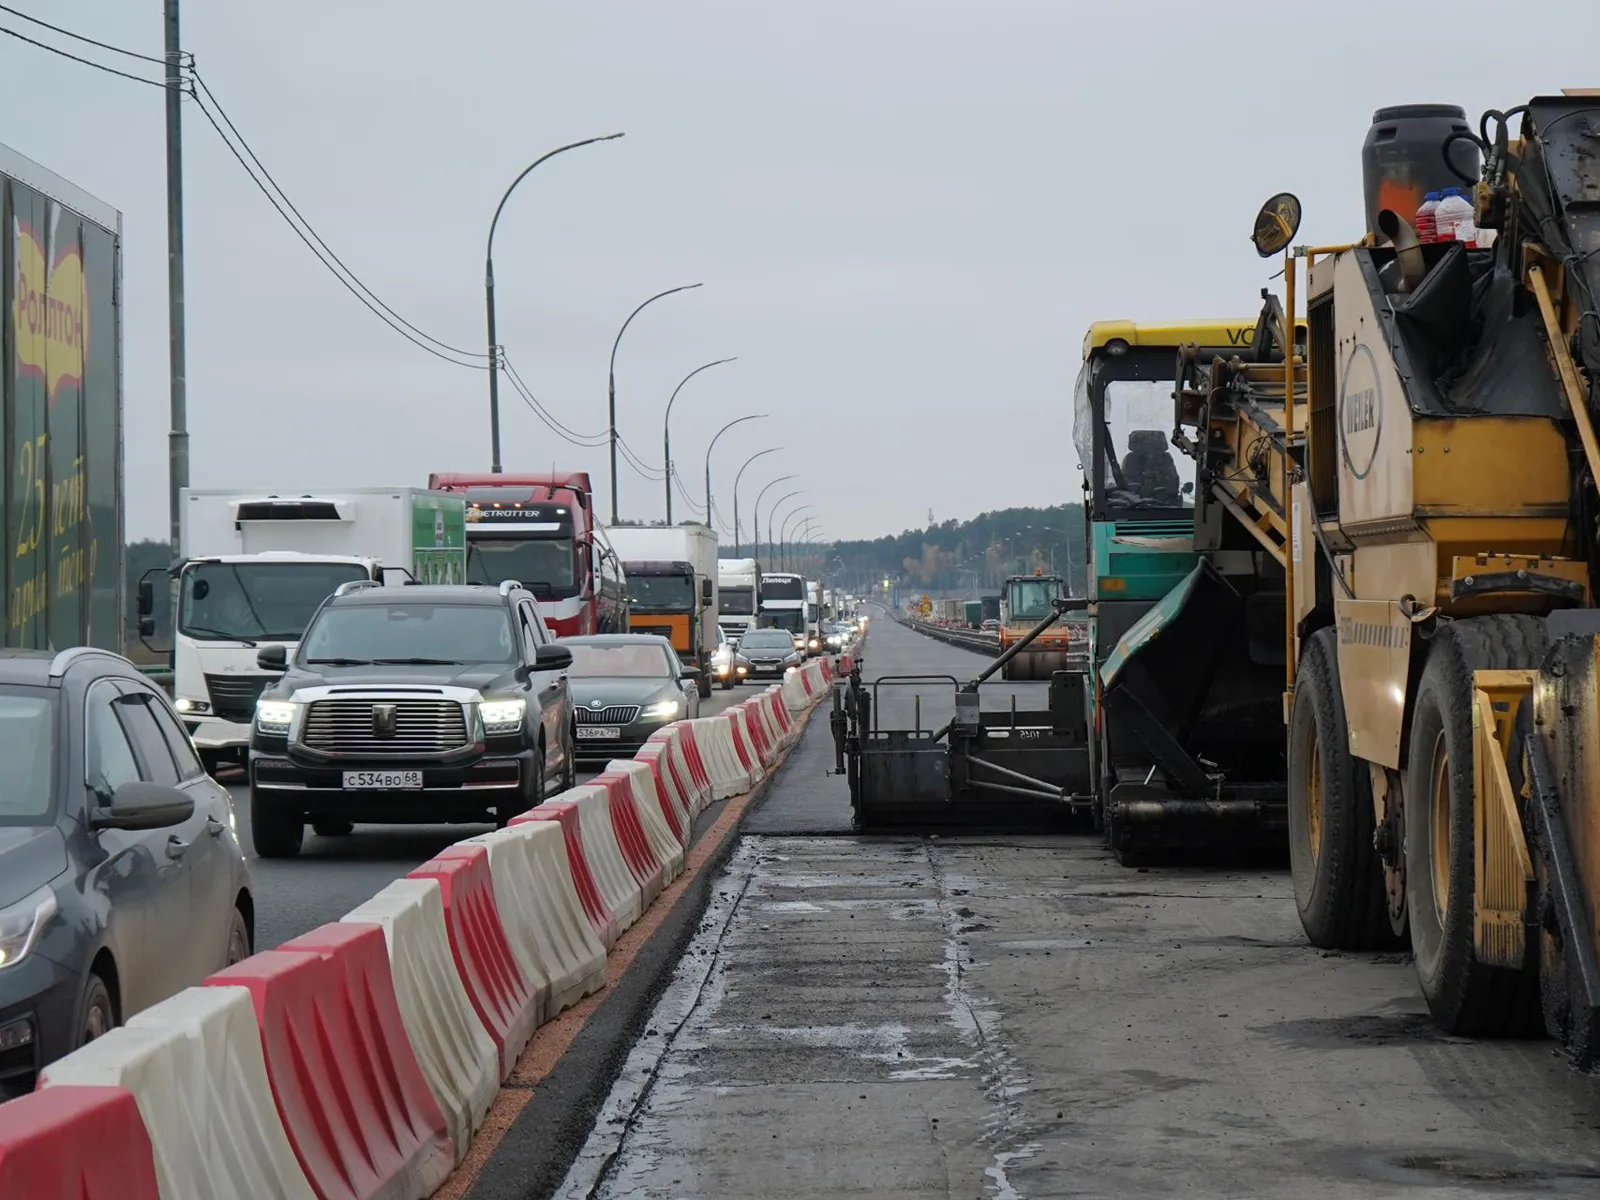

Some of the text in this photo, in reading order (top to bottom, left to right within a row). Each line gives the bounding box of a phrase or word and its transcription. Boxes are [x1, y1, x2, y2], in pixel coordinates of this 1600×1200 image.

[1346, 388, 1375, 434] WEILER
[16, 433, 46, 558] 25
[578, 729, 605, 737] 536РА
[405, 772, 418, 782] 68
